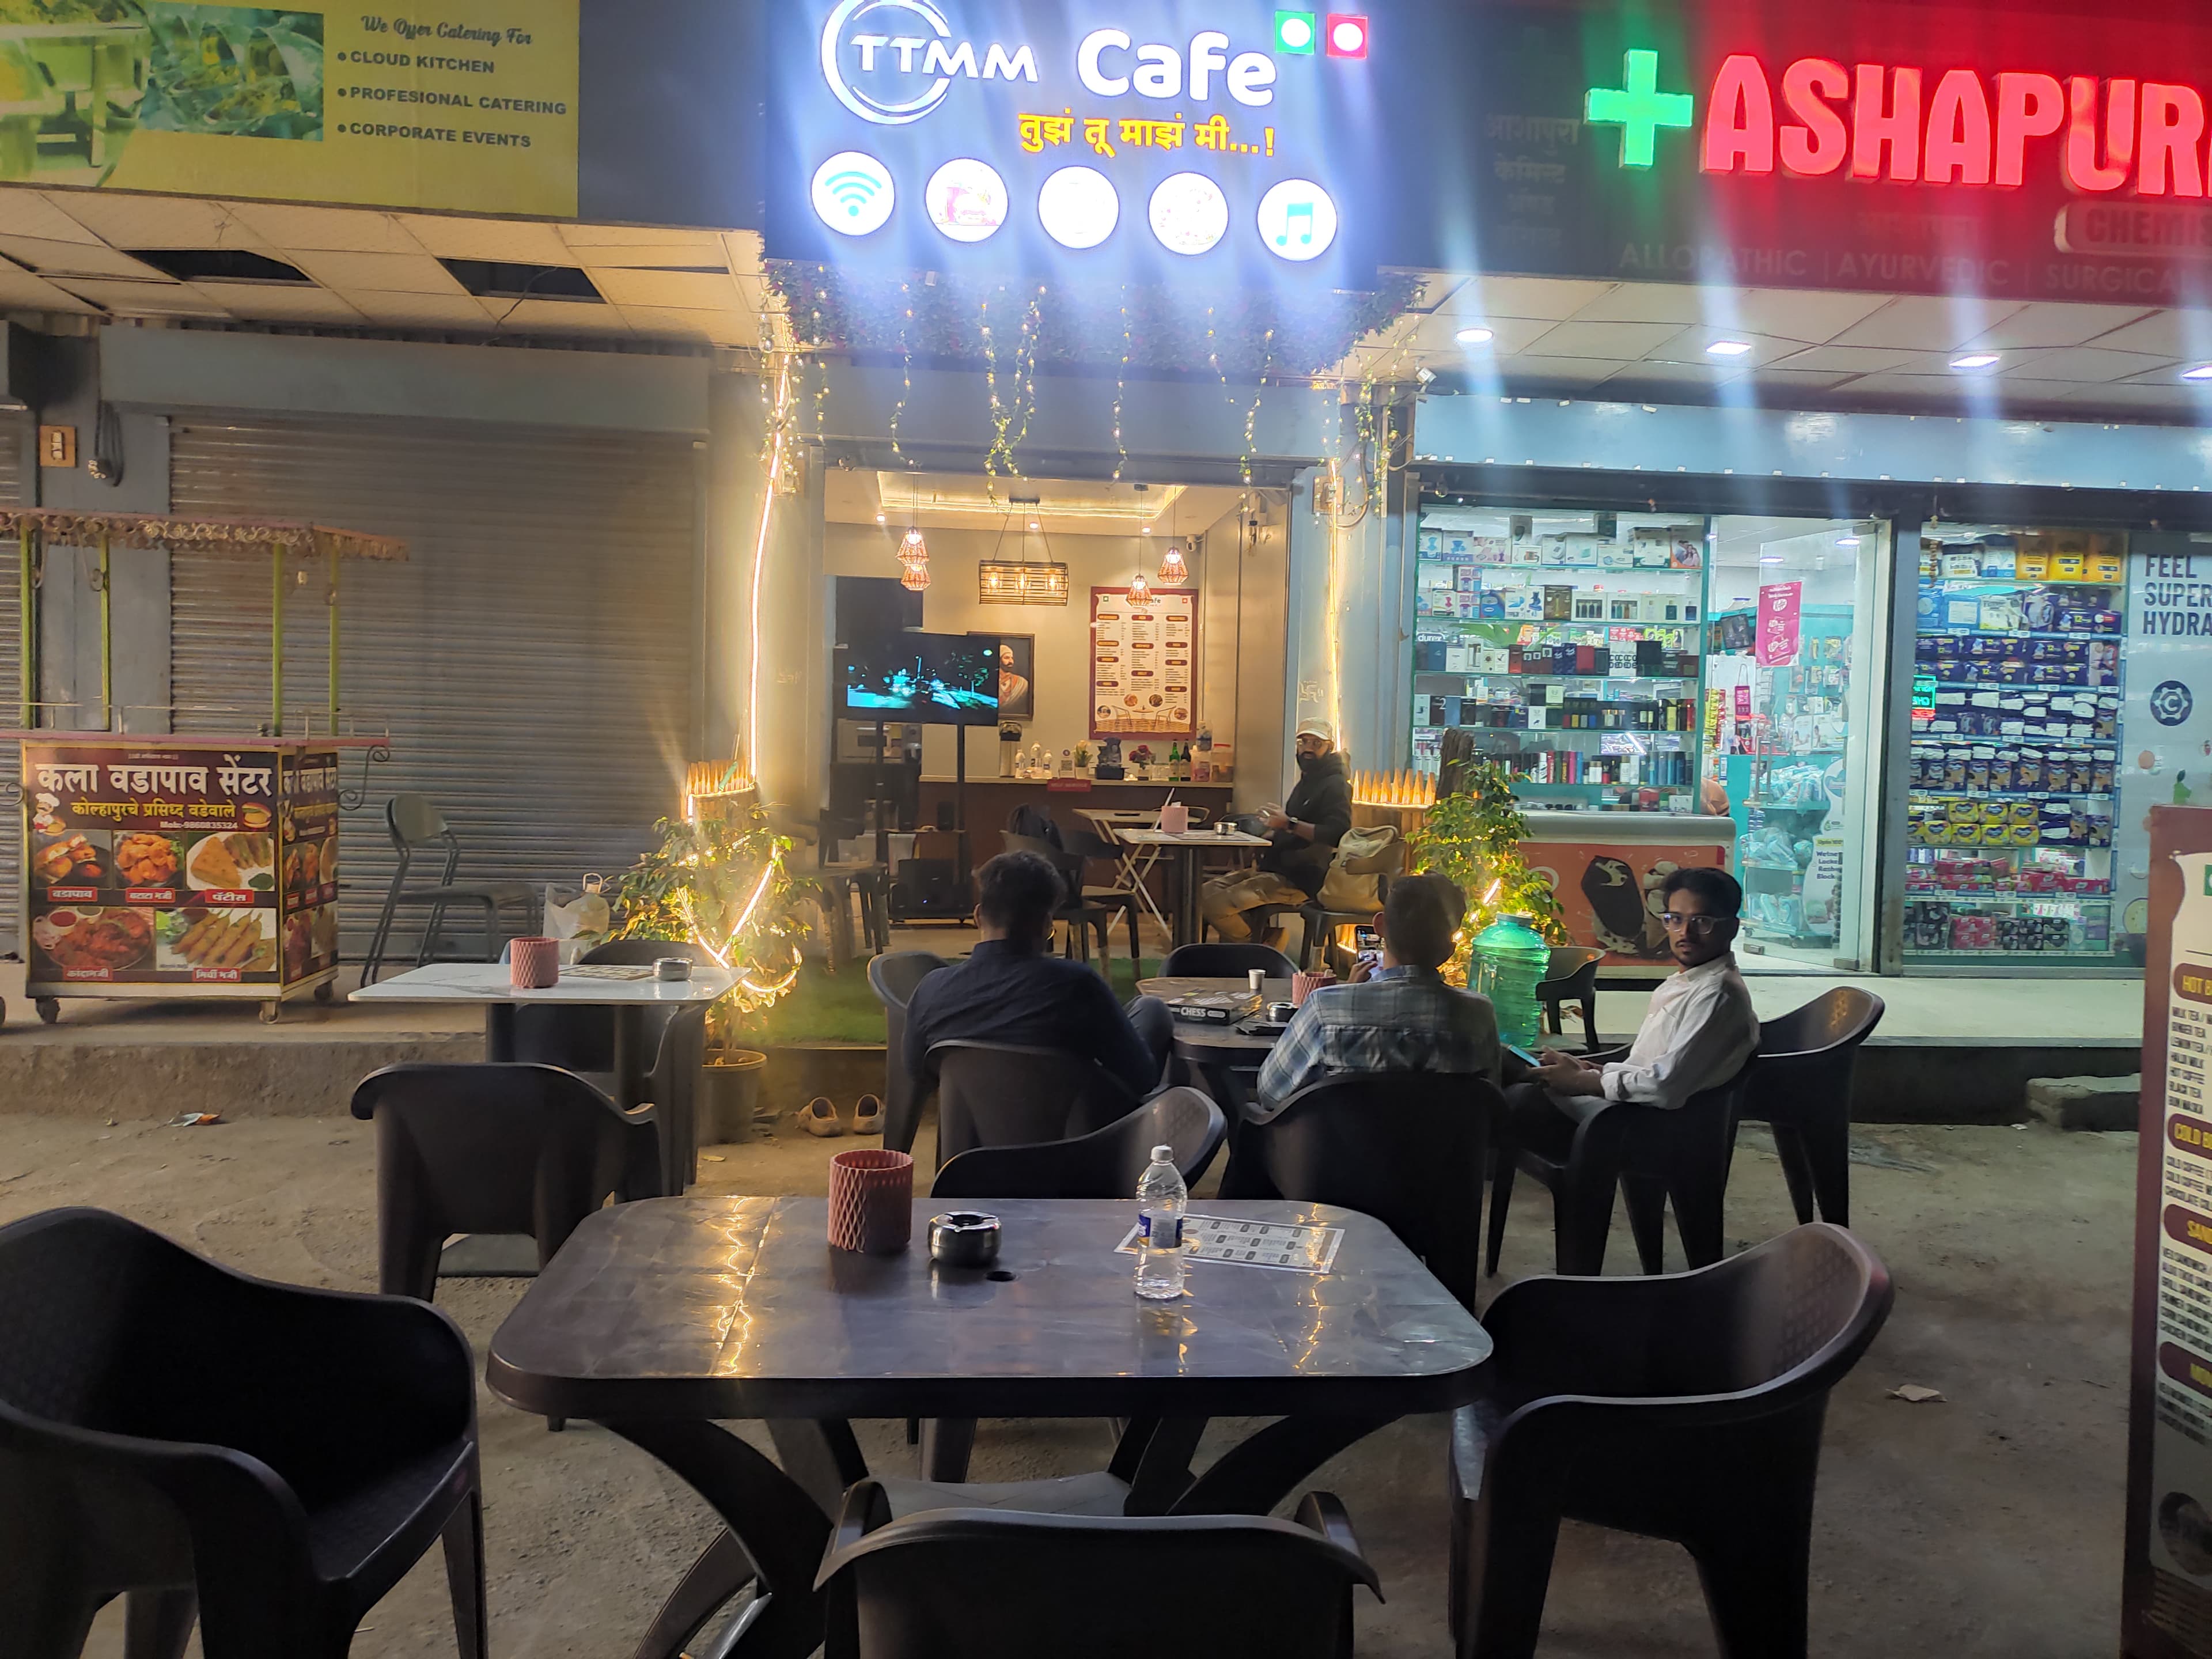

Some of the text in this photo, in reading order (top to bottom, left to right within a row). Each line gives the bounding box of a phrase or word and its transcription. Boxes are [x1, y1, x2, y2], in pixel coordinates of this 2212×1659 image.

[361, 15, 388, 33] We
[436, 22, 502, 47] Catering
[506, 28, 532, 45] For
[350, 51, 494, 73] CLOUD KITCHEN
[851, 29, 1275, 107] TTMM Cafe
[350, 86, 566, 115] PROFESIONAL CATERING
[350, 122, 531, 147] CORPORATE EVENTS
[1018, 107, 1074, 153] तुझं
[1083, 119, 1115, 158] तू
[1119, 112, 1185, 150] माझं
[1700, 54, 2212, 198] ASHAPUR
[1836, 251, 2010, 286] AYURVEDIC
[2145, 554, 2197, 578] FEEL
[2144, 582, 2212, 607] SUPER
[2142, 611, 2212, 636] HYDRA
[1418, 634, 1442, 642] durex
[35, 764, 99, 793] कला
[107, 764, 209, 795] वडापाव
[216, 753, 272, 797] सेंटर
[70, 797, 140, 822] कोल्हापुरचे
[188, 800, 236, 819] वडेवाले
[52, 889, 92, 899] वडापाव
[2183, 975, 2203, 995] HOT
[1181, 1006, 1206, 1017] CHESS
[2174, 1123, 2201, 1145] COLD
